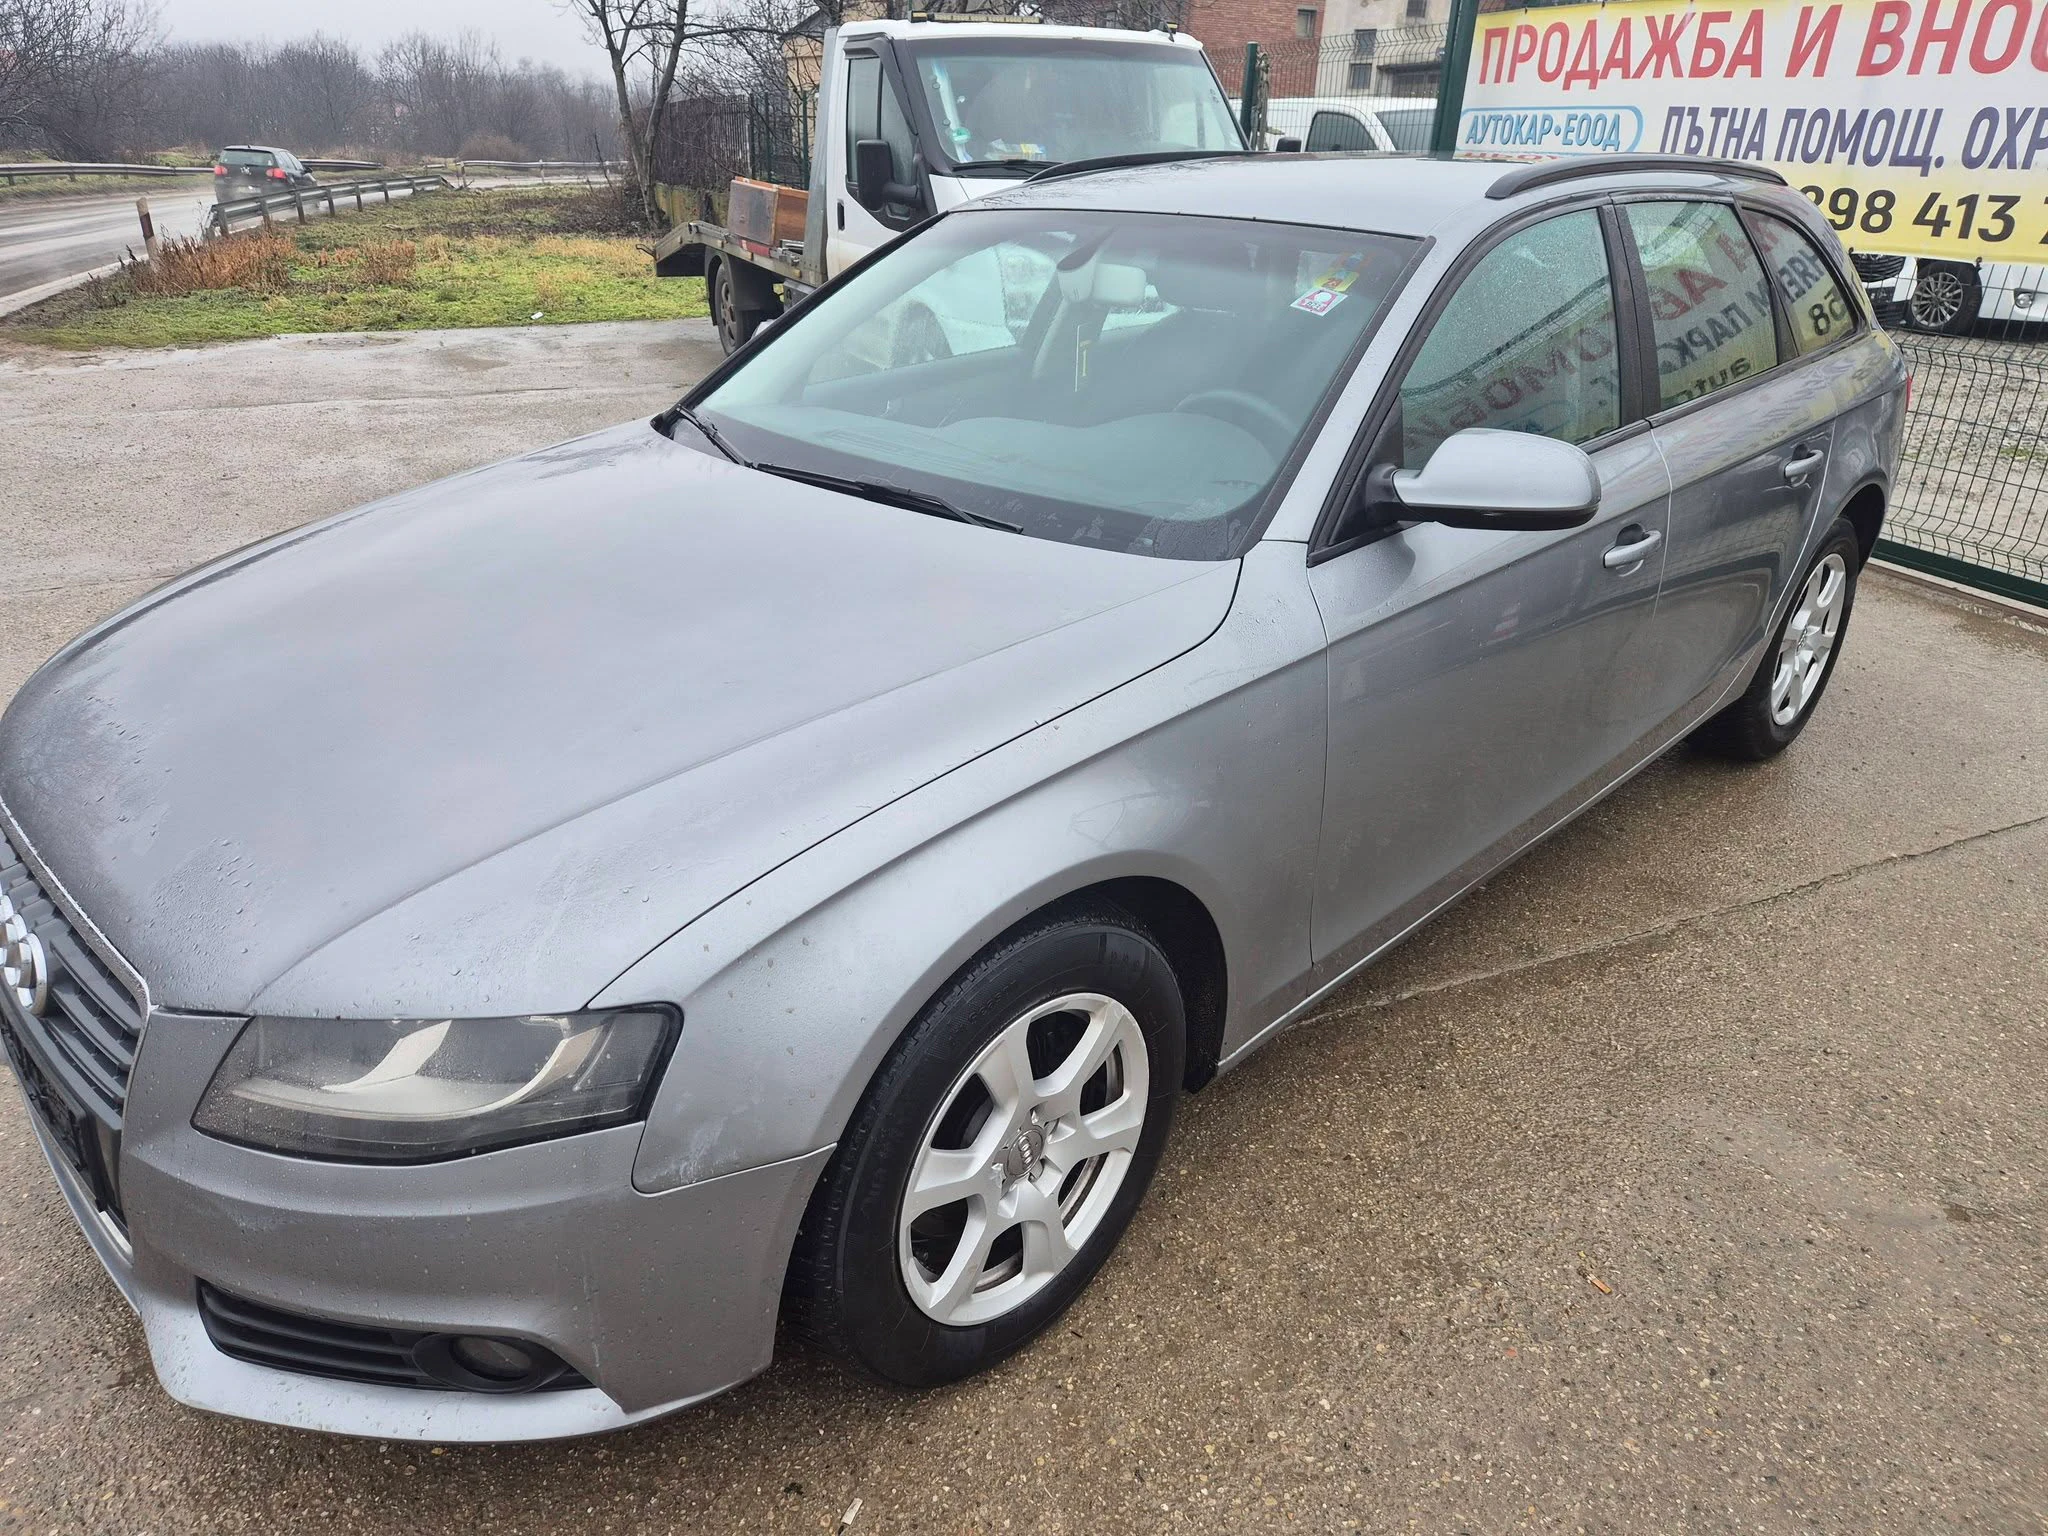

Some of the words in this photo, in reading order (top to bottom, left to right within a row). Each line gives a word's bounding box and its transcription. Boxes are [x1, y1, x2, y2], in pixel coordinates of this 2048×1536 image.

[1479, 9, 1764, 91] ПРОДАЖБА
[1785, 4, 1843, 78] И
[1659, 106, 1768, 161] ПЪТНА
[1774, 108, 1944, 177] ПОМОЩ.
[1913, 192, 2021, 243] 413
